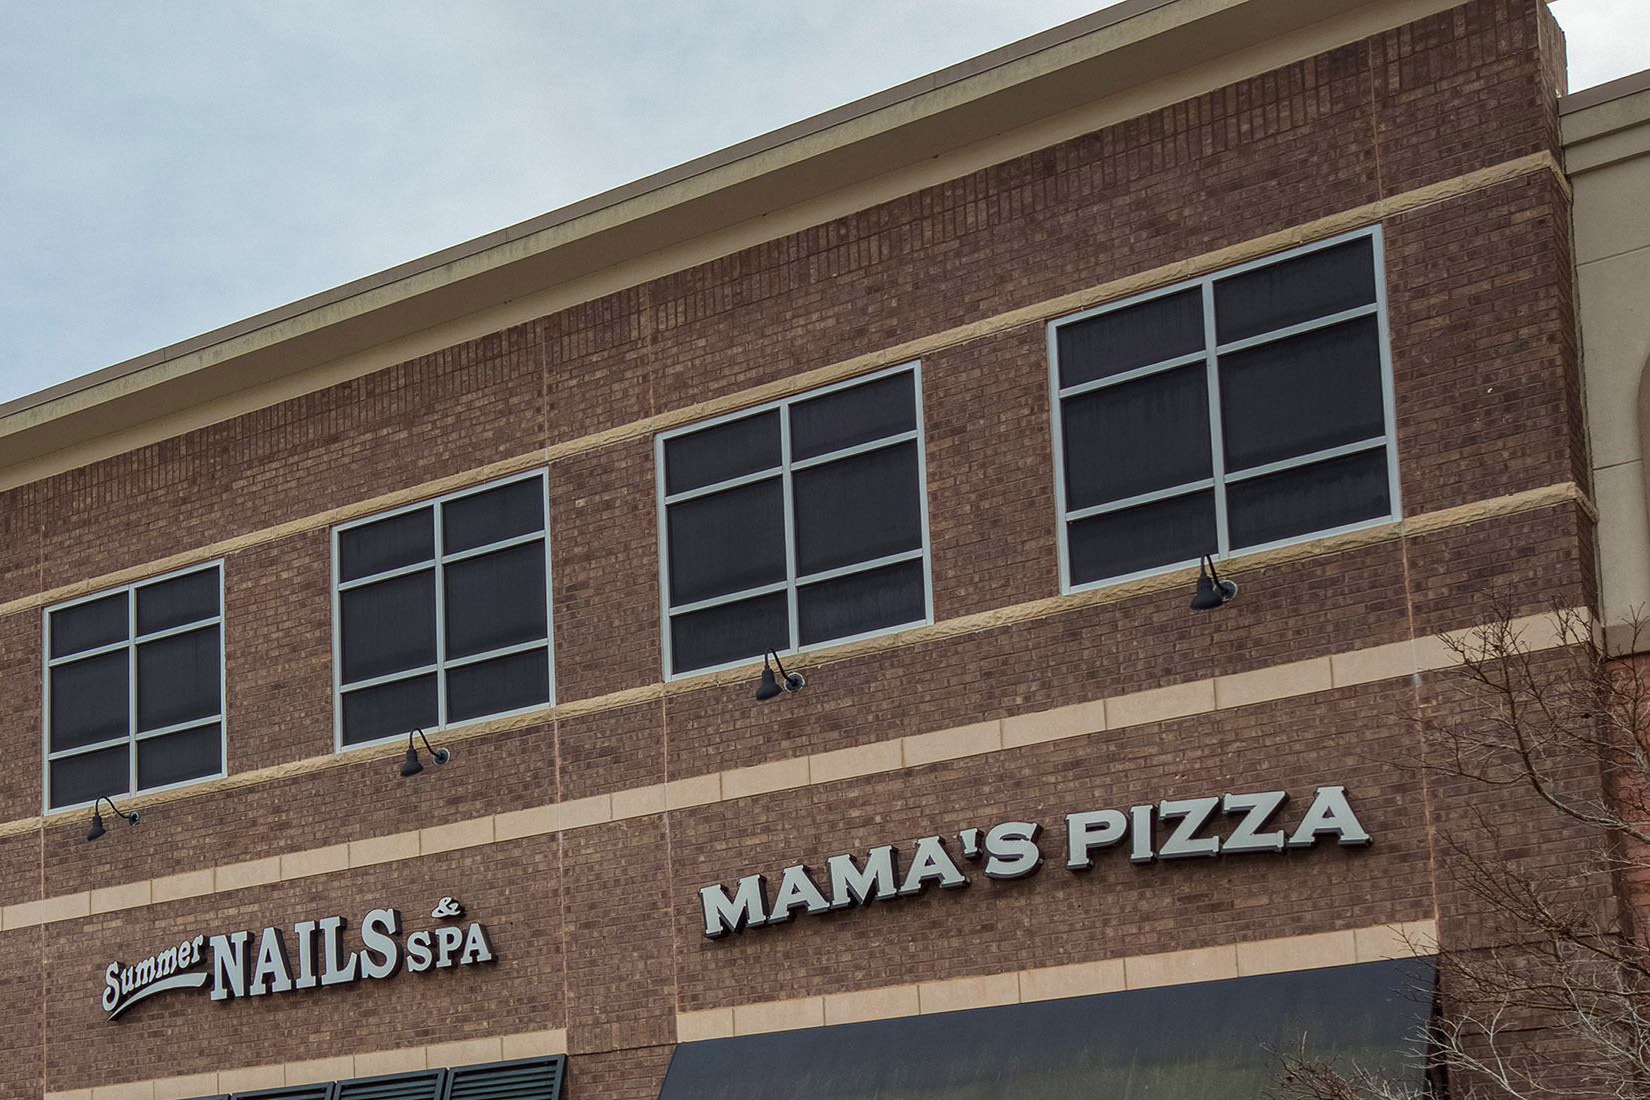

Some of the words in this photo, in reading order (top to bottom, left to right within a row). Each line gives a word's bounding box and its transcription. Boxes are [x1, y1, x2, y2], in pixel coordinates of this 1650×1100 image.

[698, 820, 1042, 938] MAMA'S
[1065, 785, 1372, 871] PIZZA
[406, 921, 494, 974] SPA
[430, 896, 463, 919] &
[101, 933, 205, 1013] Summer
[209, 907, 402, 1002] NAILS
